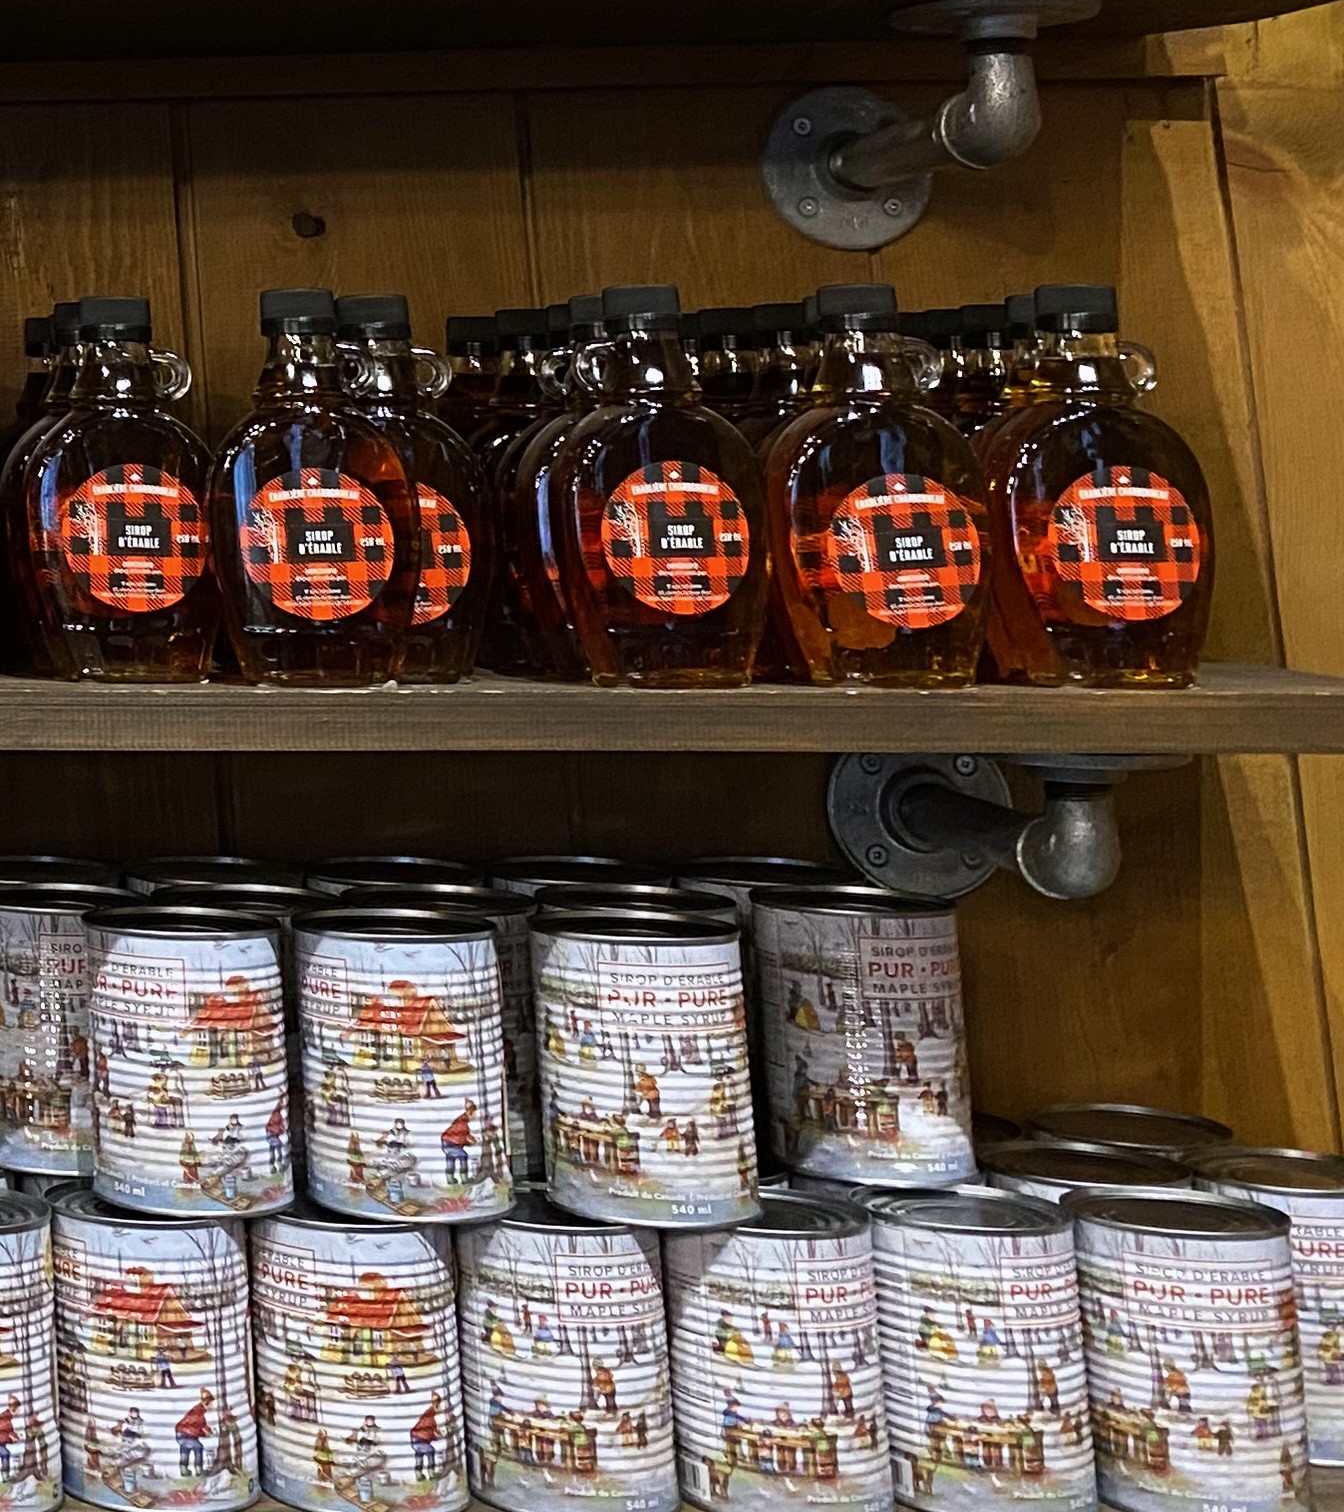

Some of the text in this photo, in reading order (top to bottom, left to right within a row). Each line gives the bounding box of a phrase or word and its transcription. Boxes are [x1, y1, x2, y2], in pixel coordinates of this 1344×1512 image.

[125, 524, 152, 536] SIROP
[305, 530, 333, 542] SIROP
[667, 524, 695, 537] SIROP
[1117, 529, 1145, 542] SIROP
[118, 535, 160, 549] D'ÉRABLE
[299, 541, 343, 555] D'ÉRABLE
[661, 536, 704, 550] D'ÉRABLE
[895, 536, 923, 549] SIROP
[1110, 541, 1154, 554] D'ÉRABLE
[889, 548, 933, 562] D'ÉRABLE
[52, 943, 81, 954] SIRO
[872, 946, 912, 957] SIROP
[868, 962, 915, 978] PUR
[611, 972, 657, 986] SIROP
[122, 979, 177, 998] PURE
[873, 982, 926, 995] MAPLE
[678, 989, 728, 1008] PURE
[681, 1013, 729, 1026] SYRUP
[114, 1180, 145, 1198] 540 ml
[671, 1204, 712, 1215] 540 ml
[568, 1264, 613, 1277] SIROP
[808, 1269, 849, 1282] SIROP
[566, 1282, 613, 1300] PUR
[806, 1286, 848, 1305] PUR
[1011, 1284, 1052, 1301] PUR
[1134, 1280, 1270, 1306] PUR PURE
[570, 1304, 626, 1318] MAPLE
[811, 1307, 860, 1322] MAPLE
[626, 1498, 646, 1511] 540
